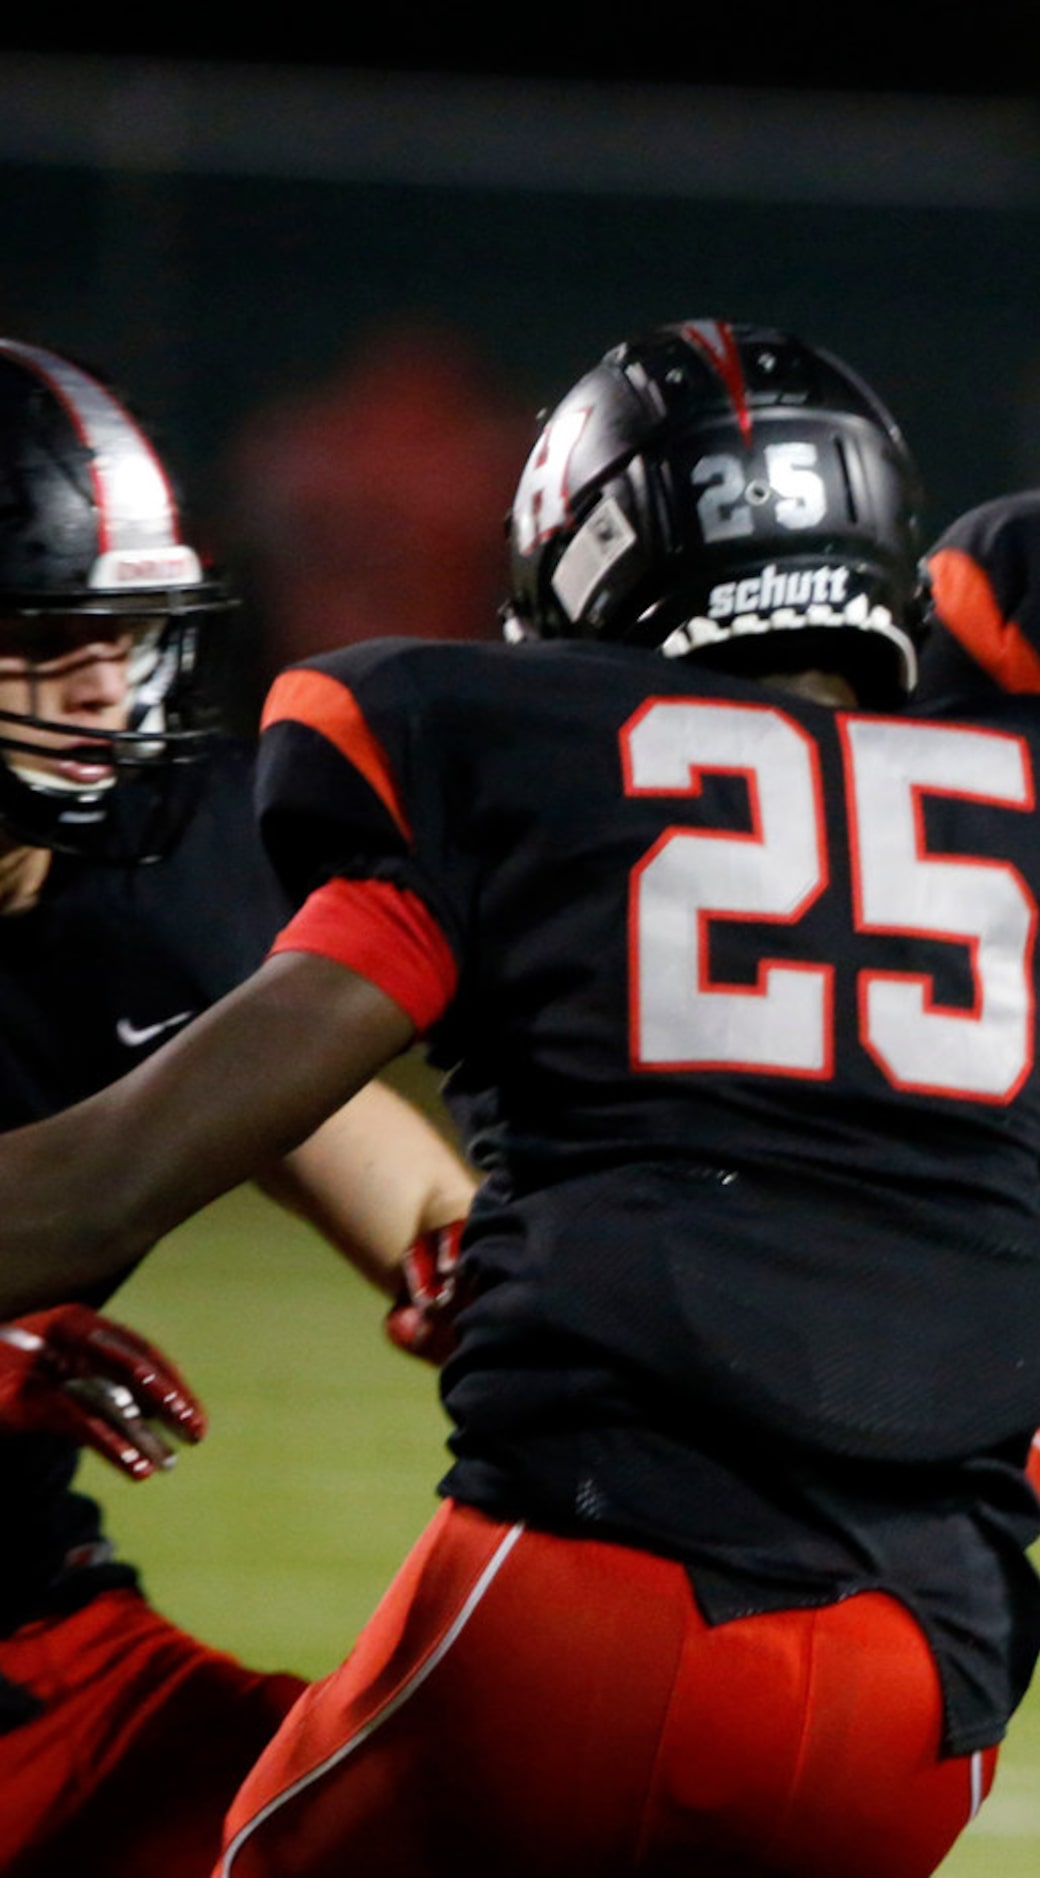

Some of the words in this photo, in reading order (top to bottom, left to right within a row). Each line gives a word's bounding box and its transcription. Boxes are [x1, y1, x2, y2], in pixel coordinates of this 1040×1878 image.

[690, 441, 827, 543] 25
[708, 563, 849, 620] schutt
[619, 696, 1040, 1106] 25
